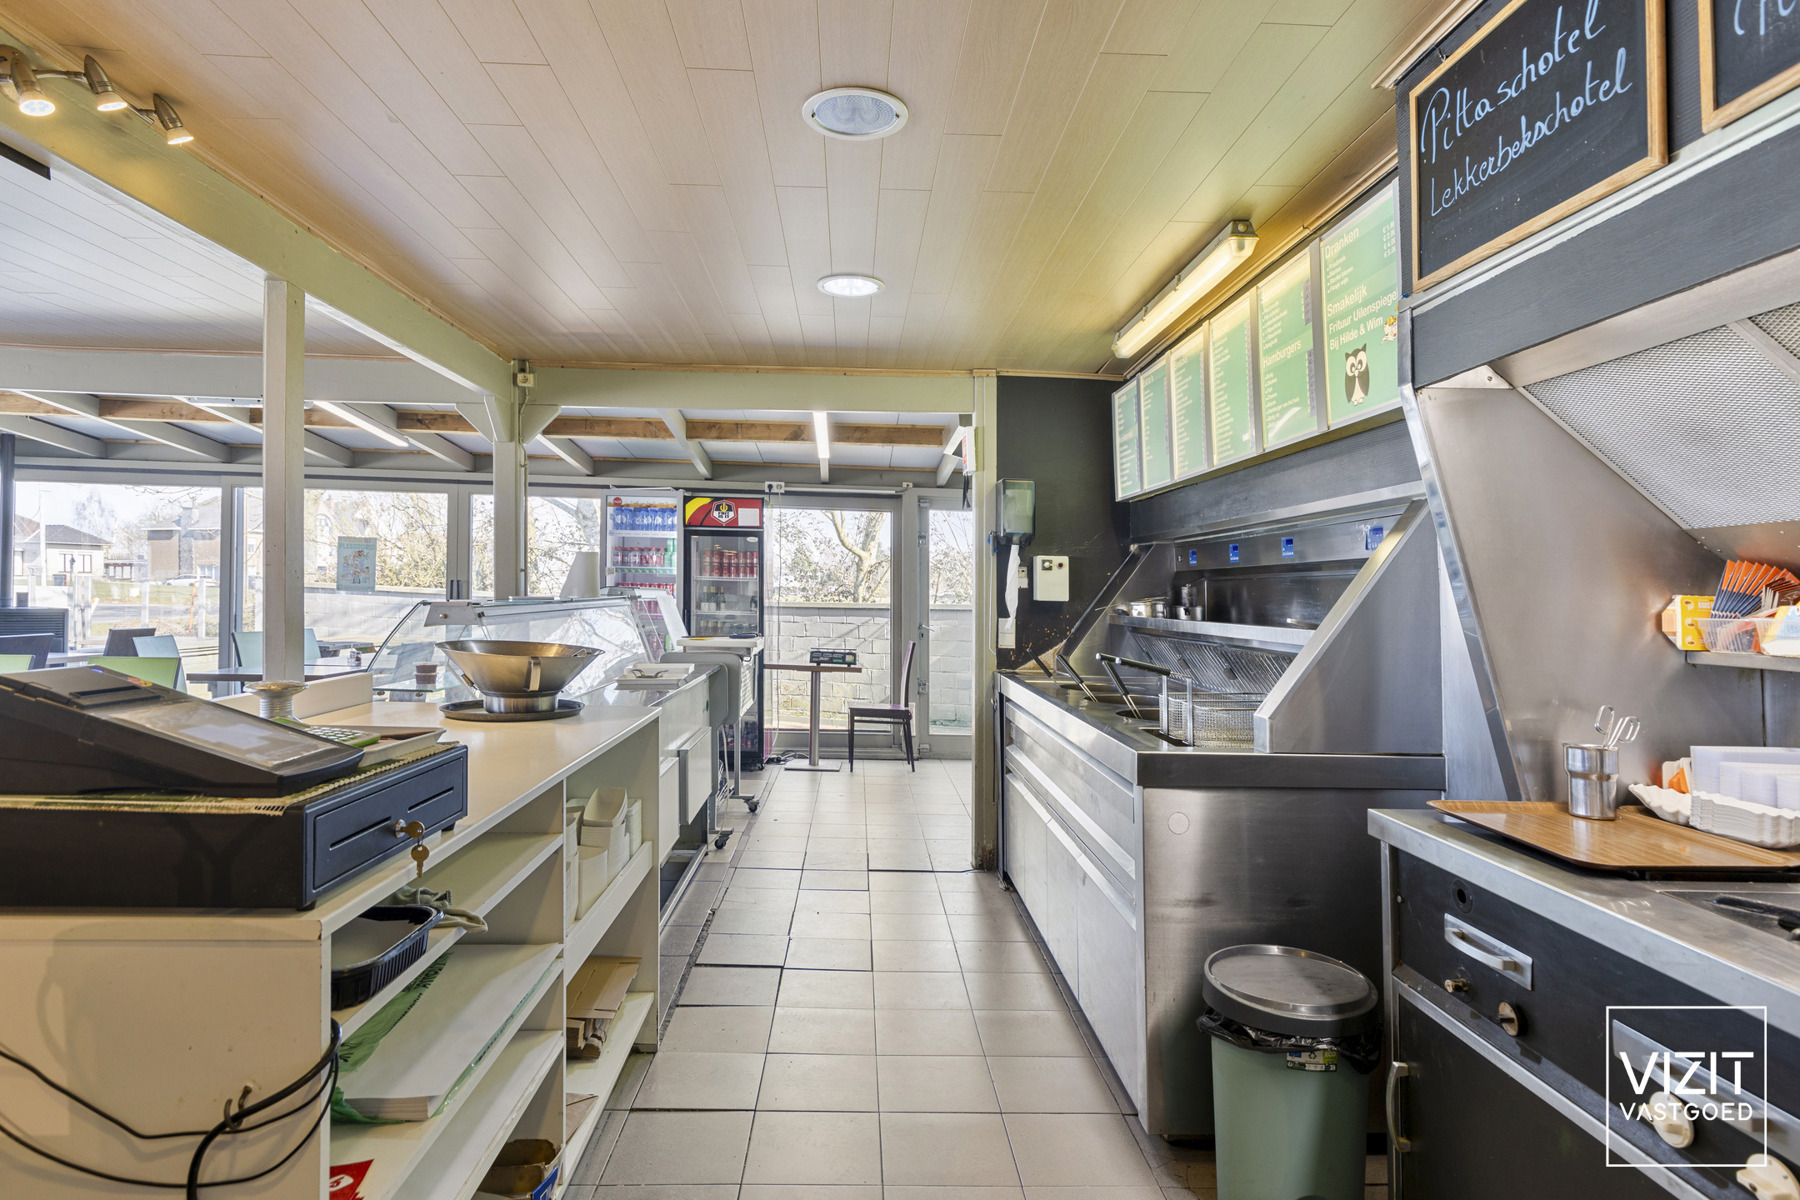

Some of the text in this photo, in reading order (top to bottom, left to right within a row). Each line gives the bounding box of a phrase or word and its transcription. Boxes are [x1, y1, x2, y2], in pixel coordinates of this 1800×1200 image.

[1431, 47, 1633, 217] Lekkerbekschotel
[1325, 227, 1360, 259] Dranken
[1327, 284, 1368, 317] Smakelijk
[1329, 315, 1352, 335] Frituur
[1330, 316, 1383, 351] Bij Hilde & Wim
[1263, 339, 1302, 368] Hamburgers
